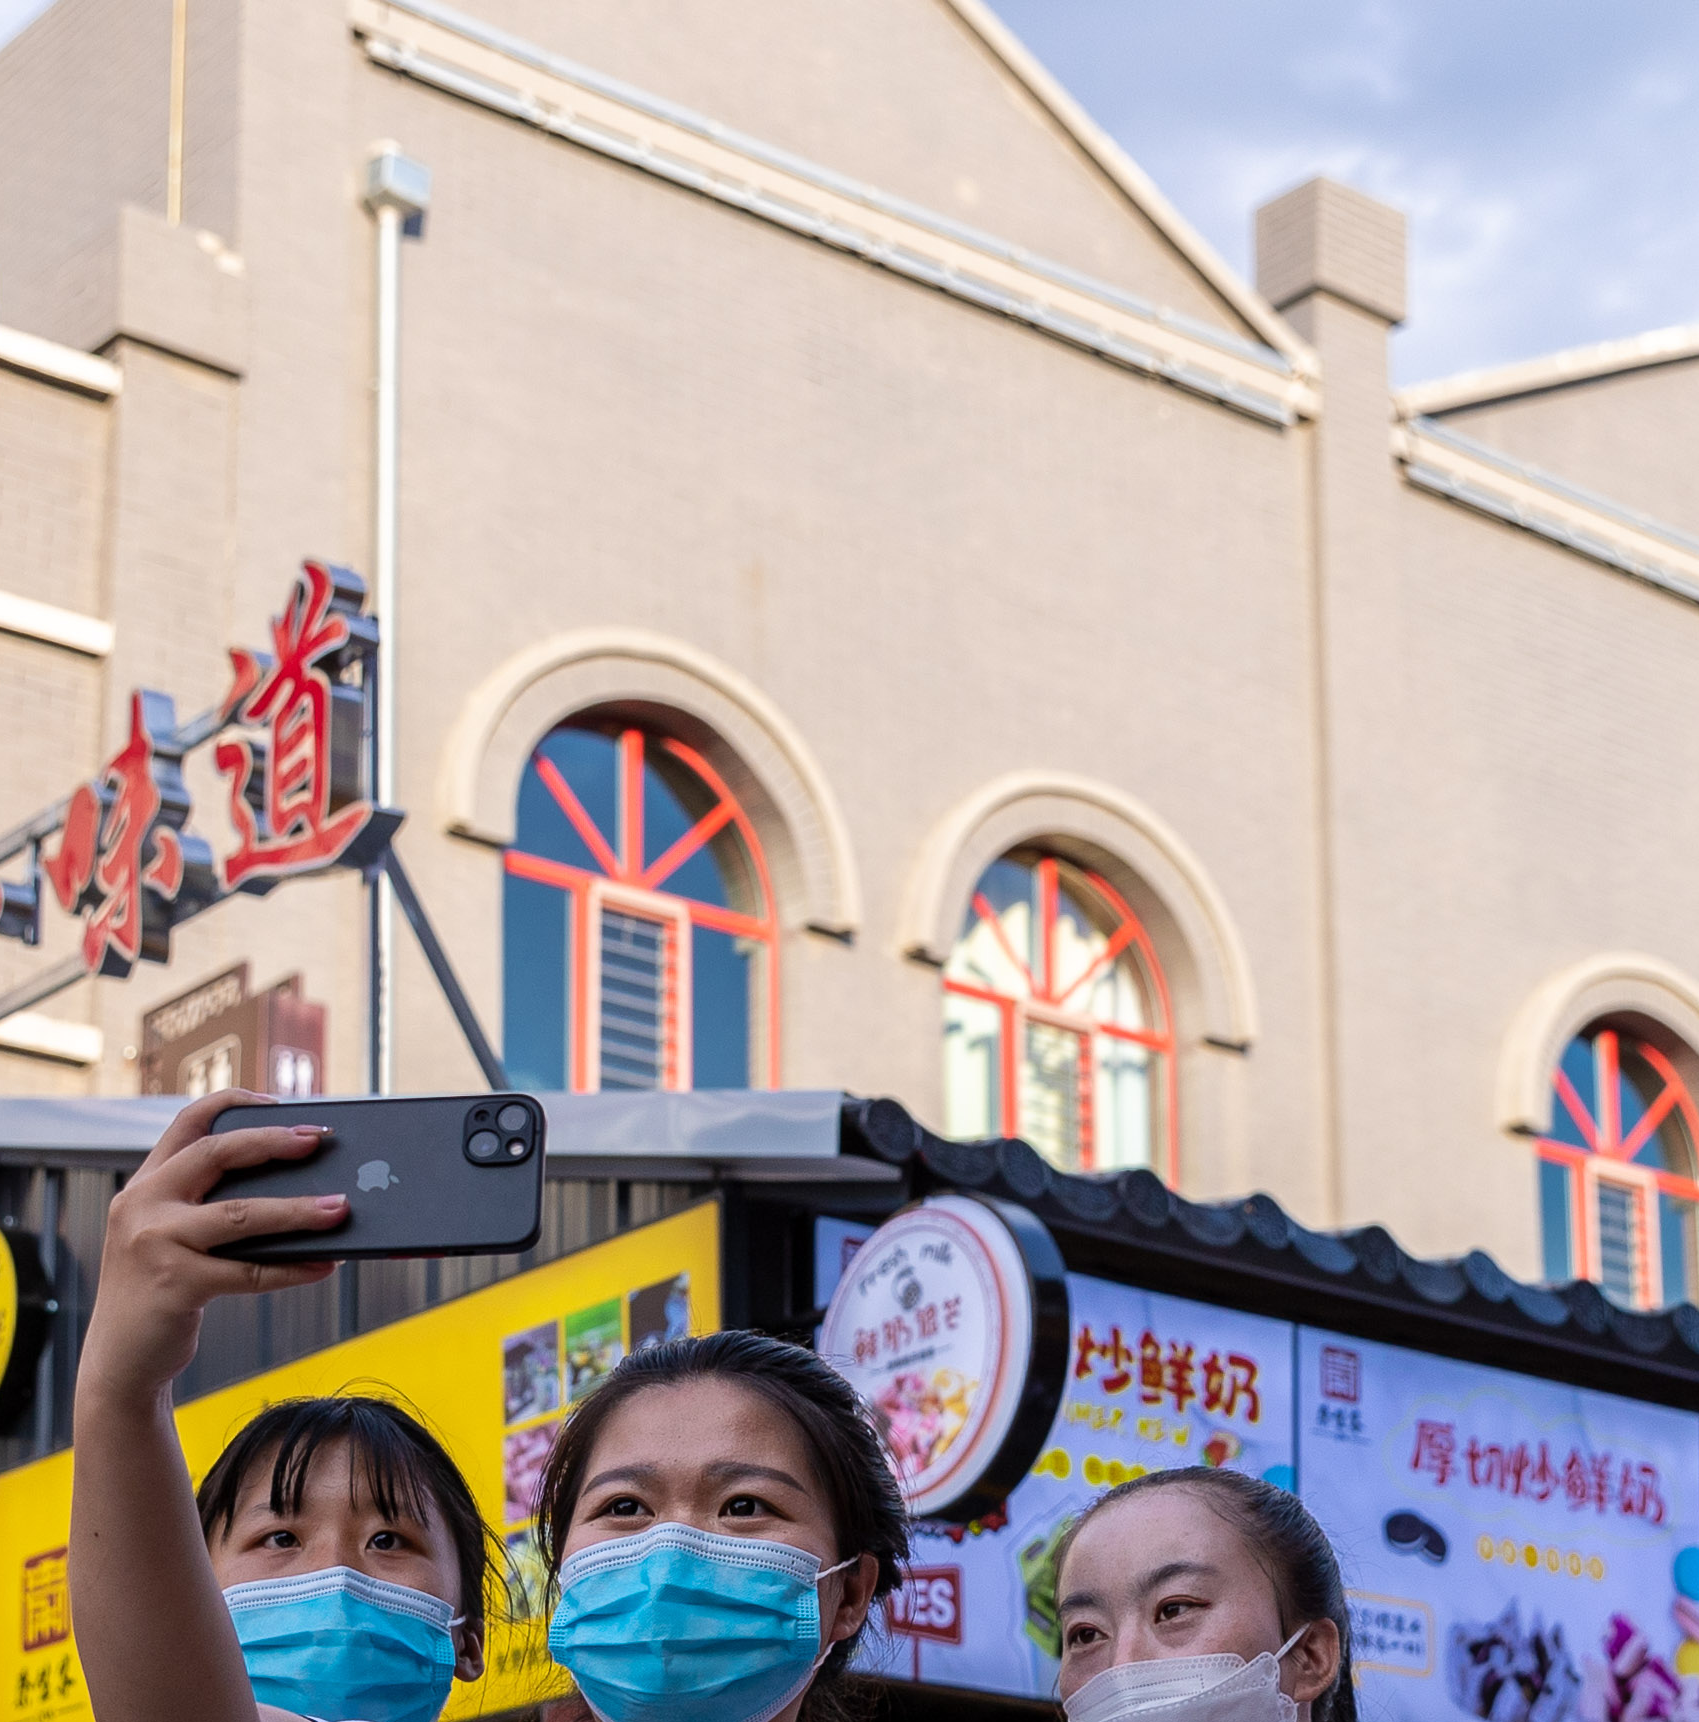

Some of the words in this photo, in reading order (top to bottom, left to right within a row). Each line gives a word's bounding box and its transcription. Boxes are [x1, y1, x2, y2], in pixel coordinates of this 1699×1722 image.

[1074, 1323, 1262, 1424] 炒鲜奶
[1411, 1417, 1668, 1526] 厚切炒鲜奶
[890, 1577, 956, 1629] YES
